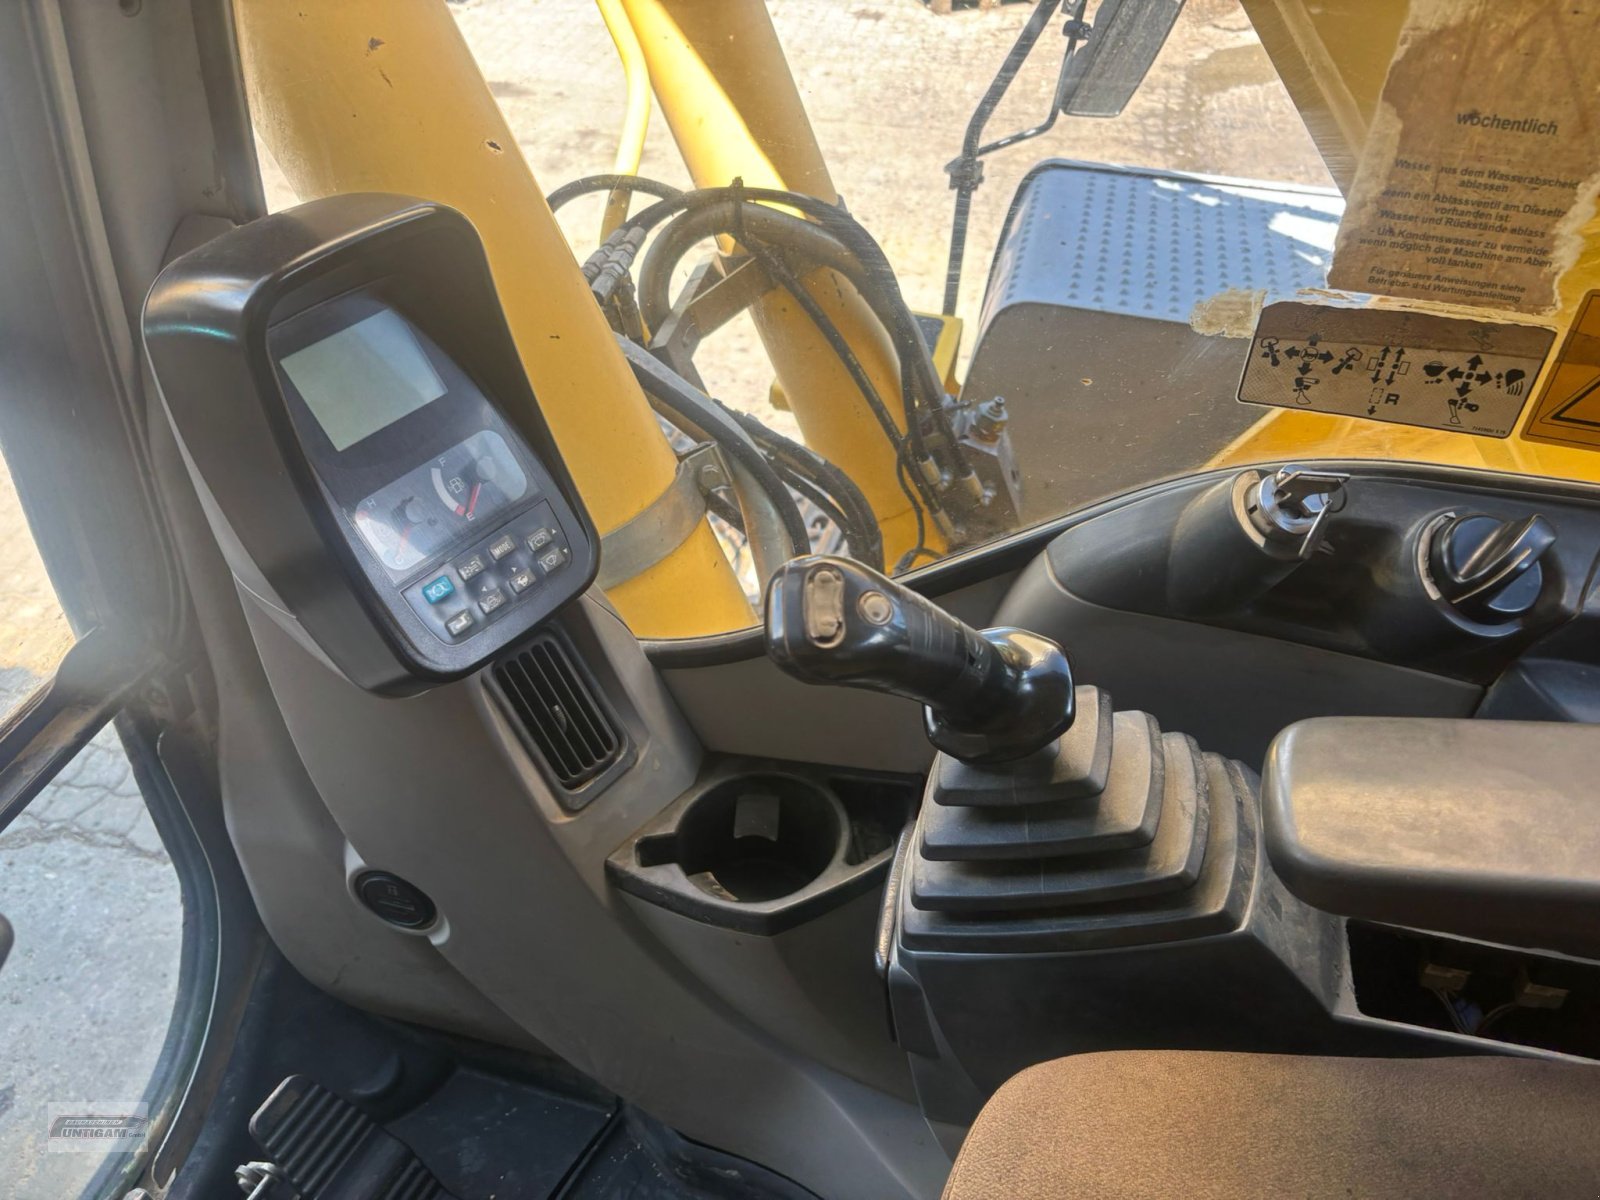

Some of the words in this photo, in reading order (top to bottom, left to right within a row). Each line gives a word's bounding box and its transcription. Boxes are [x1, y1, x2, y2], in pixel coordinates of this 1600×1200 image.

[1457, 109, 1558, 135] wöchentlich
[1460, 167, 1484, 178] dem
[1457, 179, 1508, 193] ablassen
[1413, 192, 1431, 201] ein
[1433, 193, 1502, 209] Ablassventil
[1503, 203, 1520, 212] am
[1434, 206, 1493, 221] vorhanden
[1380, 209, 1419, 223] Wasser
[1421, 215, 1443, 226] und
[1445, 217, 1508, 234] Rückstände
[1377, 226, 1395, 237] Um
[1398, 228, 1482, 248] Kondenswasser
[1483, 241, 1498, 250] zu
[1359, 238, 1387, 248] wenn
[1389, 240, 1431, 252] möglich
[1434, 244, 1451, 255] die
[1453, 246, 1504, 262] Maschine
[1505, 255, 1522, 264] am
[1426, 255, 1446, 265] voll
[1448, 257, 1483, 270] tanken
[1371, 265, 1387, 276] Für
[1388, 269, 1433, 280] genauere
[1433, 274, 1498, 290] Anweisungen
[1500, 282, 1527, 294] siehe
[1368, 275, 1410, 288] Betriebs-
[1432, 284, 1521, 305] Wartungsanleitung
[1384, 393, 1400, 405] R
[438, 457, 447, 467] F
[366, 499, 377, 509] H
[465, 511, 476, 522] E
[494, 542, 511, 555] MODE
